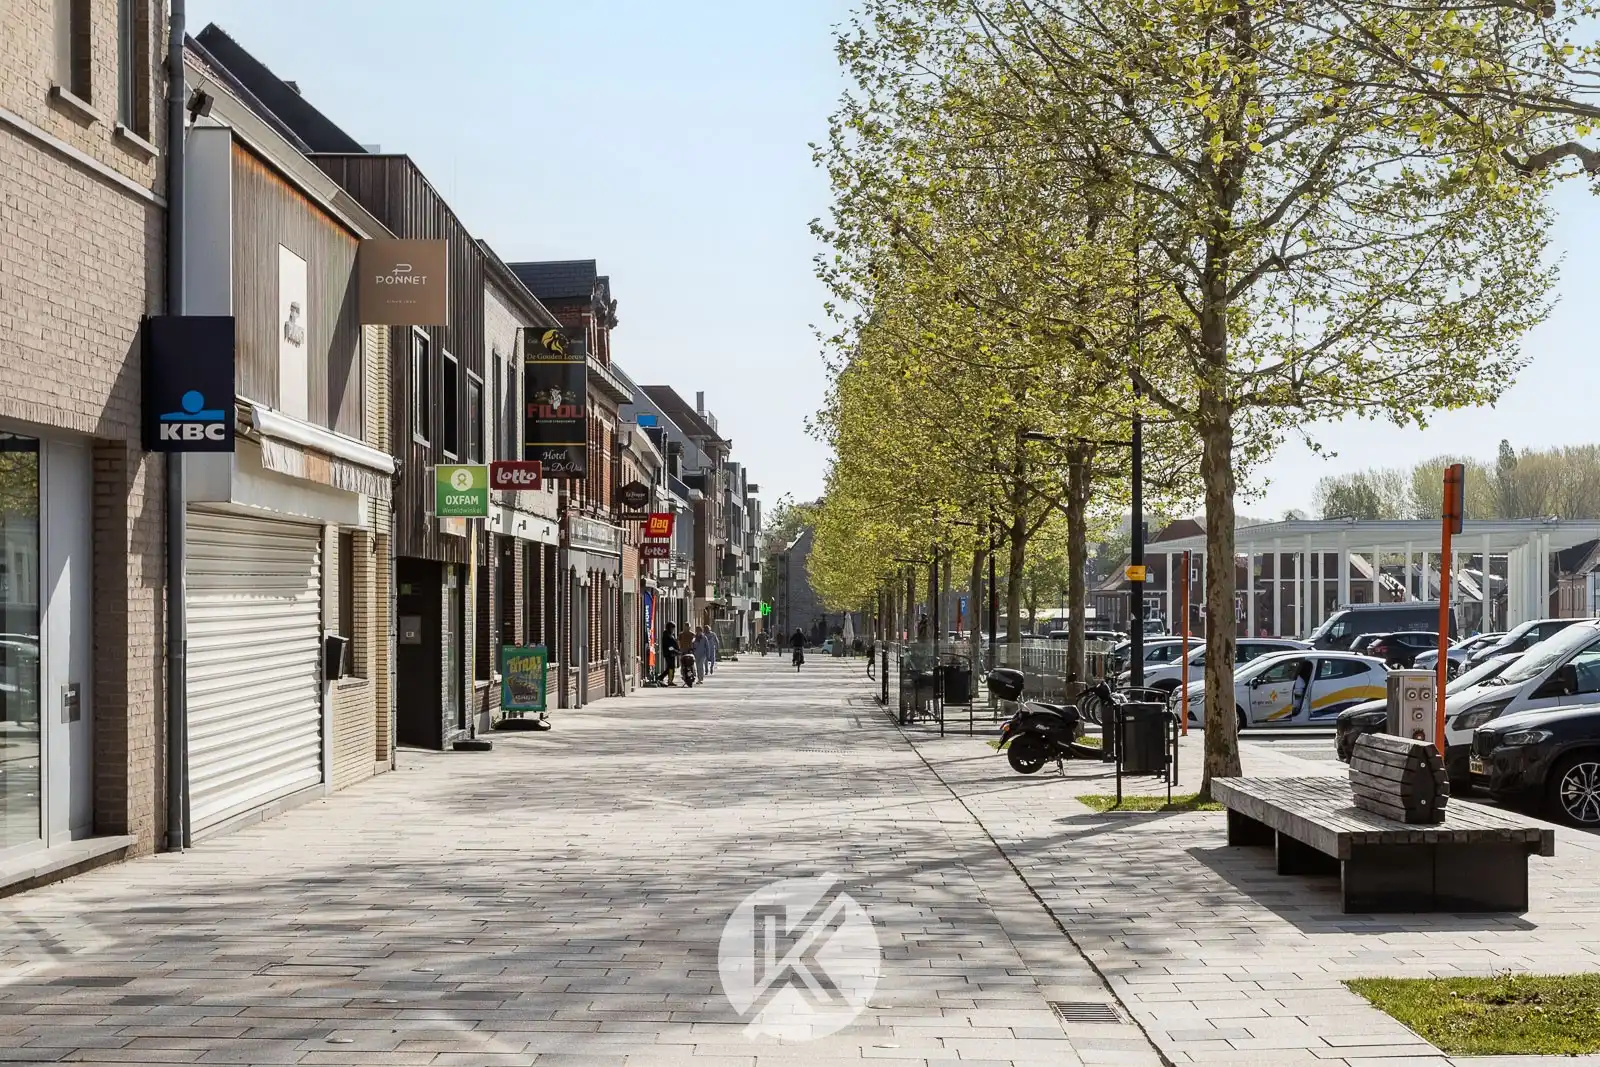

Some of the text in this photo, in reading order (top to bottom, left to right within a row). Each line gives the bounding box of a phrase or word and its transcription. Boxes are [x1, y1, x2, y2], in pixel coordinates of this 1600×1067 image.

[375, 275, 428, 285] PONNET
[526, 352, 536, 360] De
[536, 352, 563, 360] Gouden
[527, 403, 585, 419] FILOU
[160, 423, 225, 441] KBC
[542, 449, 568, 460] Hotel
[445, 495, 479, 505] OXFAM
[442, 507, 482, 515] Wereldwinkel
[650, 517, 669, 534] Dag
